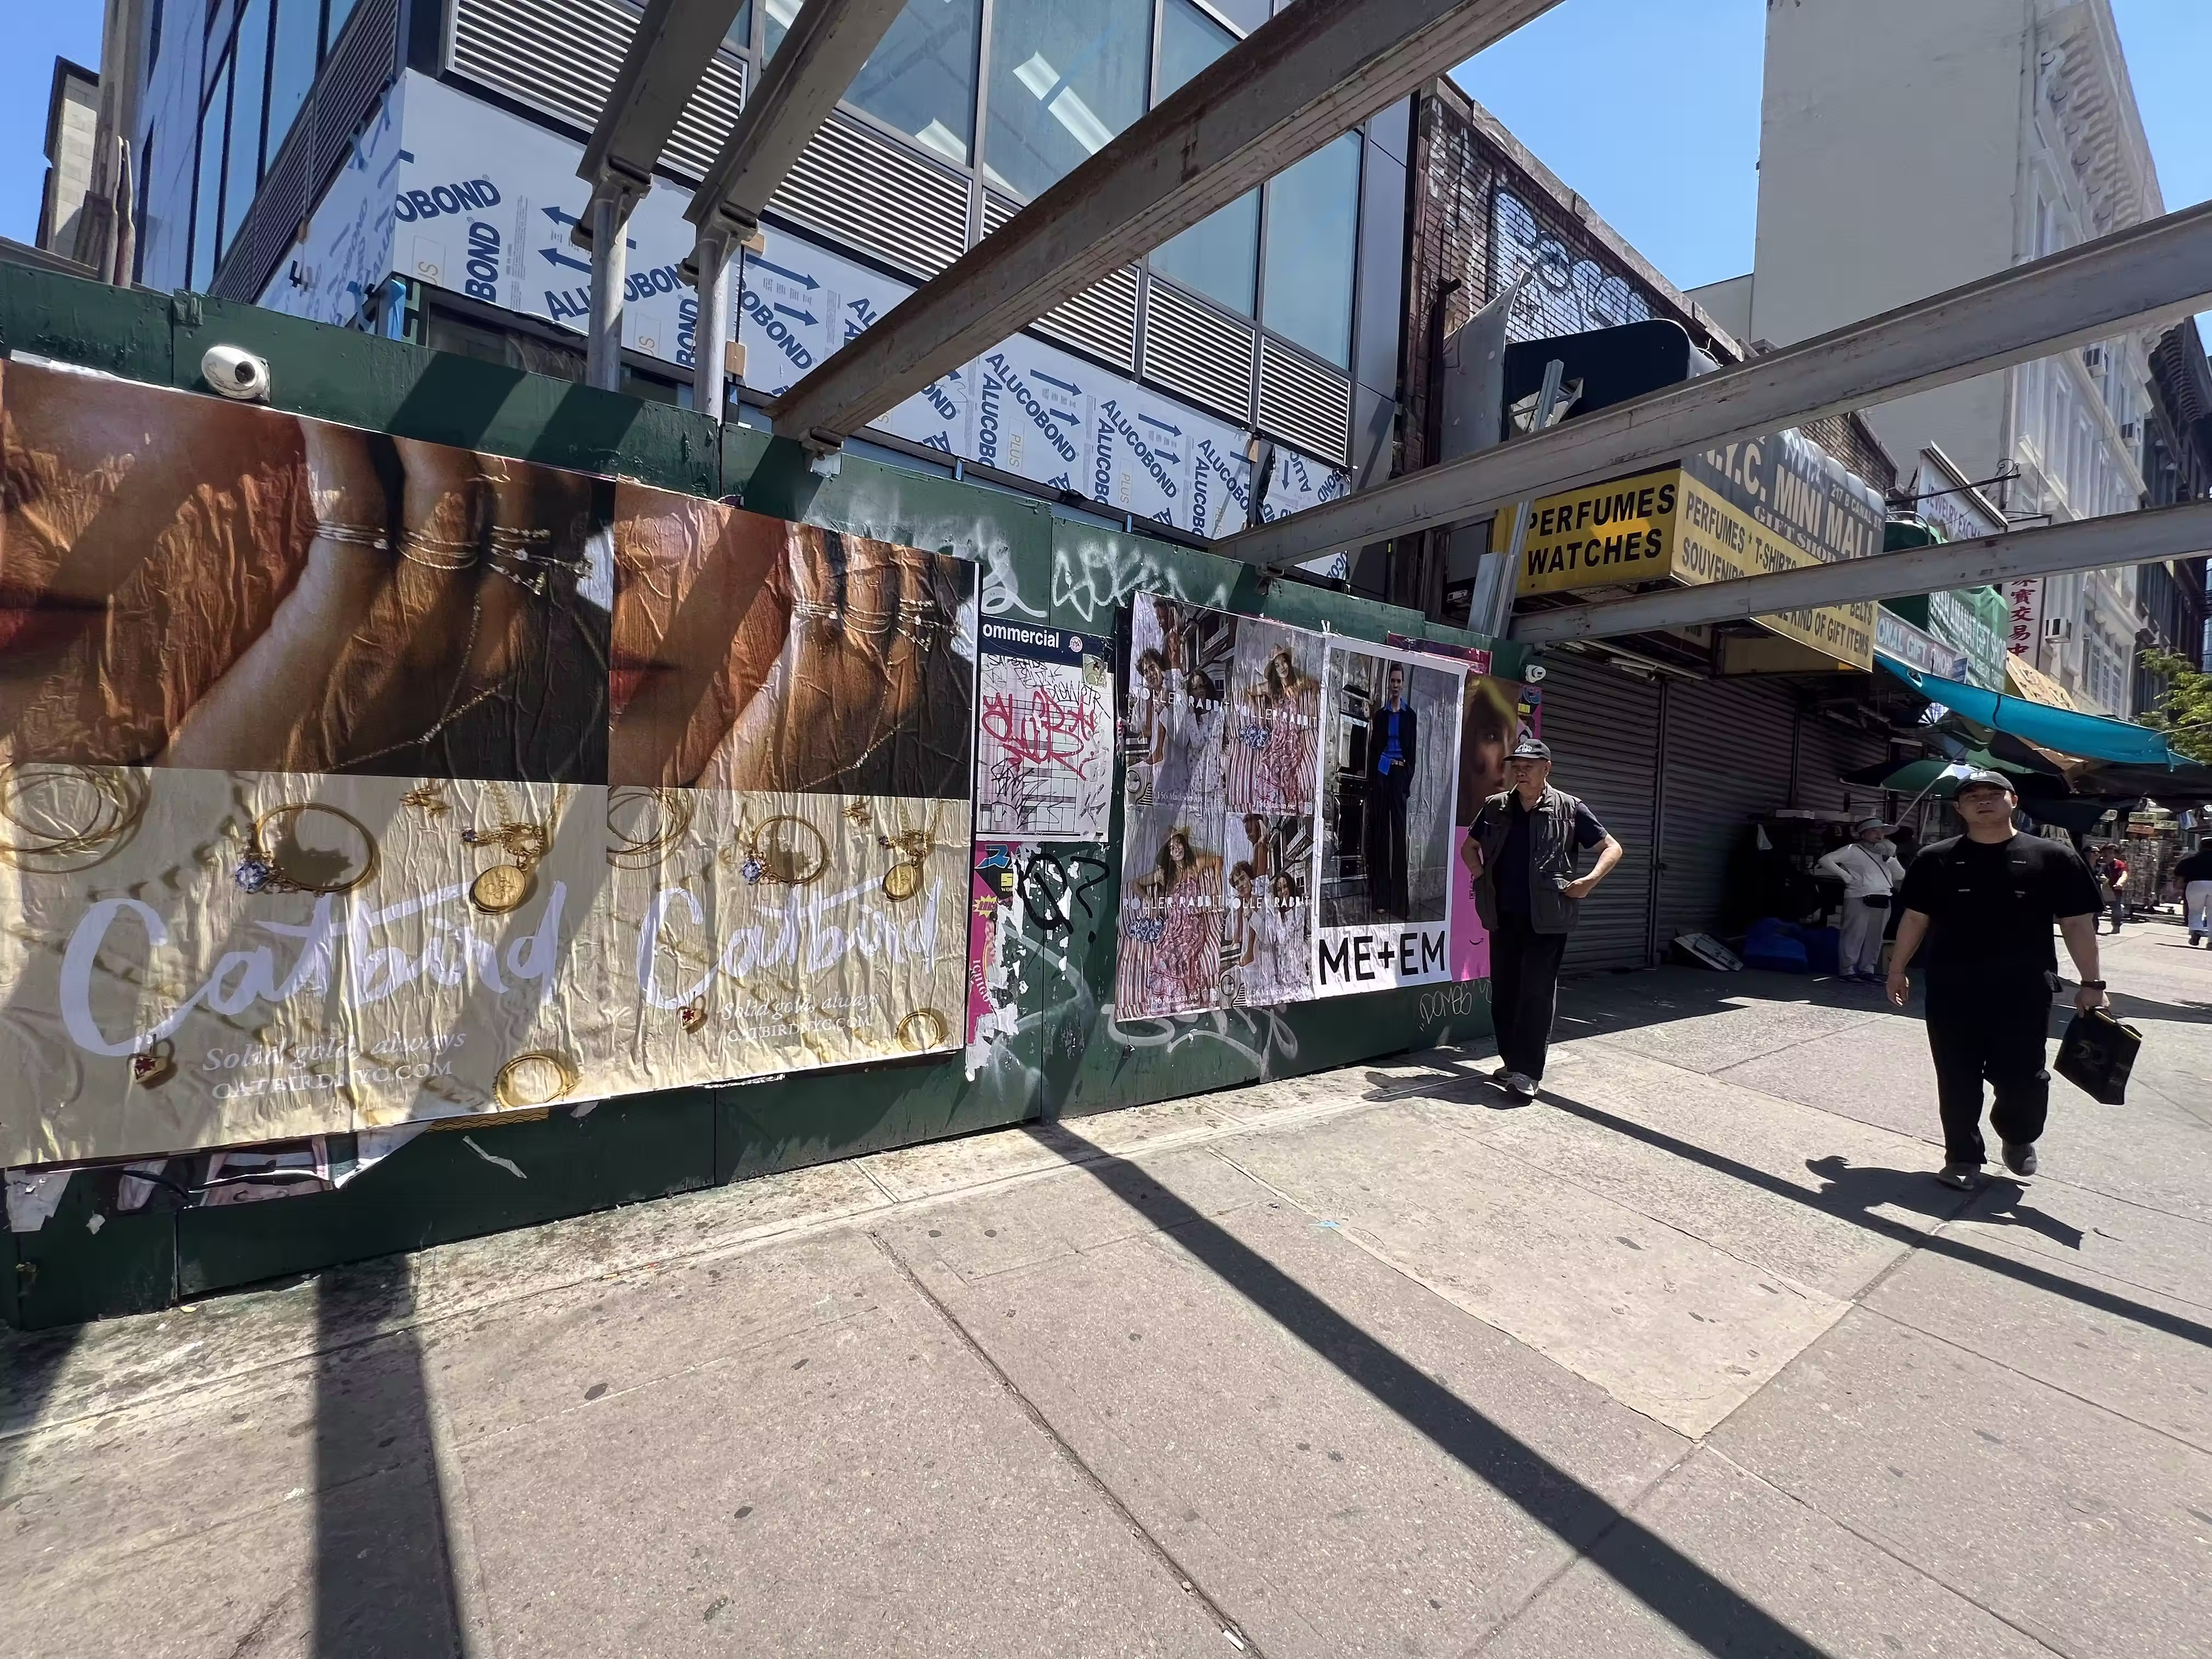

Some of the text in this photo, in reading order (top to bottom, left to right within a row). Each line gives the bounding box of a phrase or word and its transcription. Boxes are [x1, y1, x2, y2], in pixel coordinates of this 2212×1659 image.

[985, 353, 1076, 462] ALUCOBOND
[1009, 433, 1022, 467] PLUS
[1101, 399, 1177, 498] ALUCOBOND
[1120, 472, 1131, 505] PLUS
[1198, 439, 1249, 515] ALUCOBO
[1686, 490, 1746, 555] PERFUMES
[1753, 505, 1795, 541] GIFT
[1774, 464, 1822, 538] MINI
[1831, 483, 1844, 500] 217
[1850, 498, 1872, 525] CANAL
[1528, 528, 1662, 576] WATCHES
[983, 622, 1060, 648] ommercial
[1814, 612, 1827, 637] OF
[1827, 618, 1846, 647] GIFT
[1846, 627, 1870, 658] ITEMS
[1906, 634, 1927, 664] GIFT
[636, 876, 943, 1011] Catbird
[1319, 930, 1447, 985] ME+EM
[60, 879, 566, 1057] Catbird
[723, 998, 769, 1020] Solid
[371, 1031, 467, 1056] always
